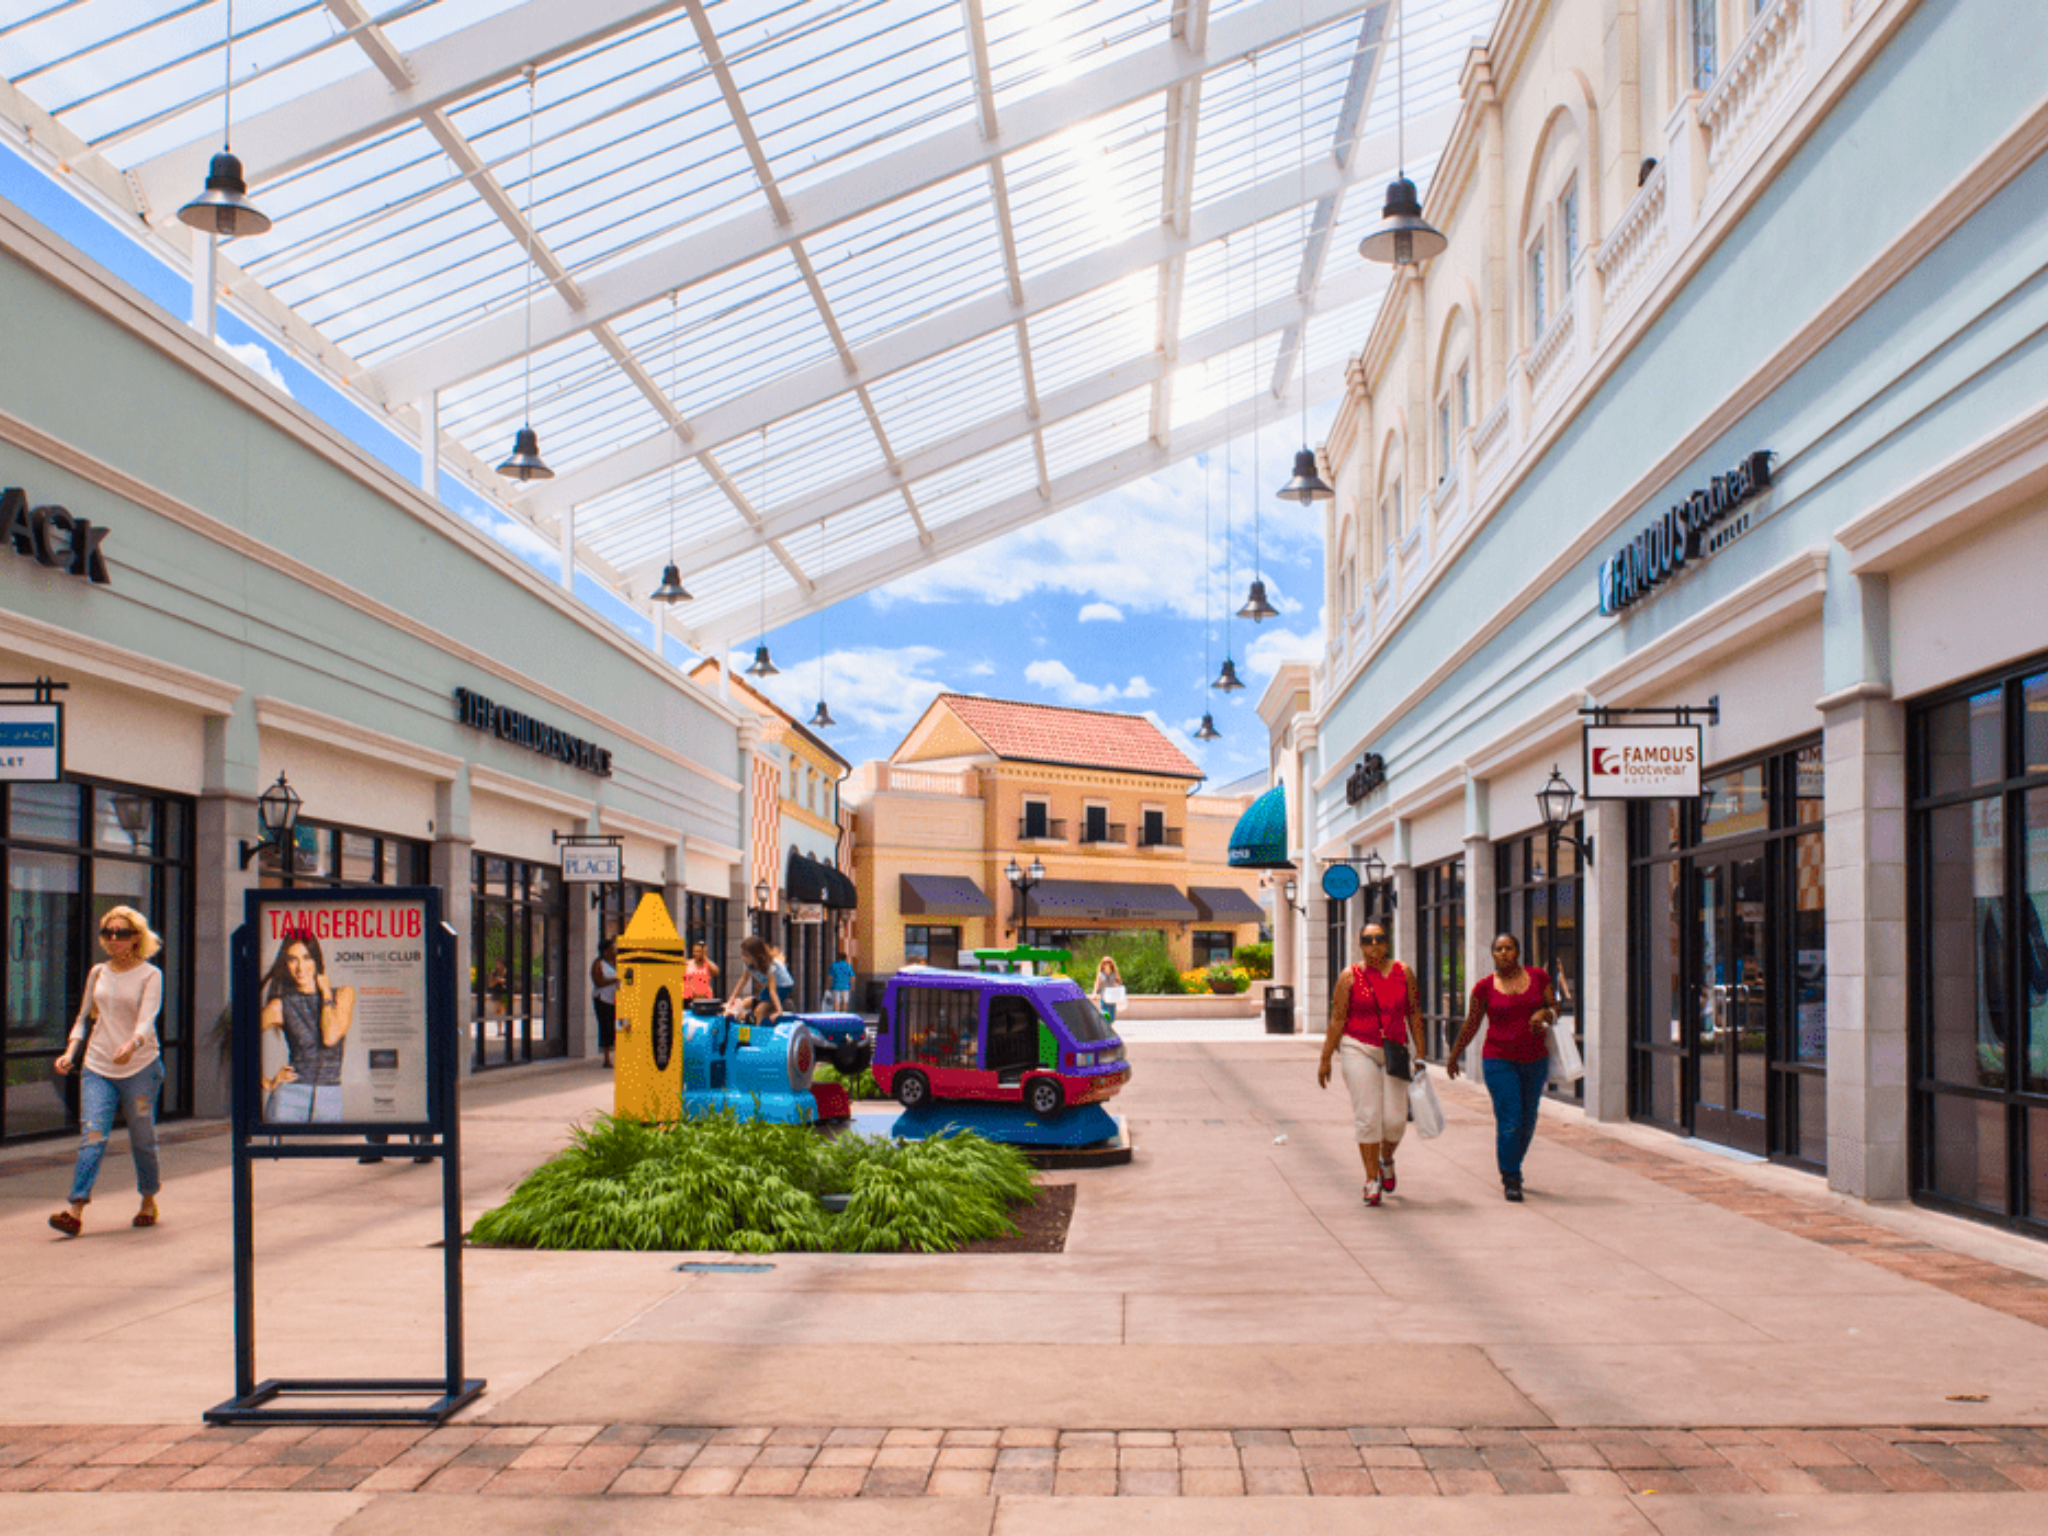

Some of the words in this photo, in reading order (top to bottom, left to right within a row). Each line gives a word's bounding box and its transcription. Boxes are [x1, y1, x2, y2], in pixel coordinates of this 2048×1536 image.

[1611, 504, 1688, 610] FAMOUS
[1622, 746, 1695, 762] FAMOUS
[1622, 763, 1687, 776] footwear
[565, 859, 617, 874] PLACE
[267, 909, 422, 940] TANGERCLUB
[657, 1000, 669, 1065] CHANGE
